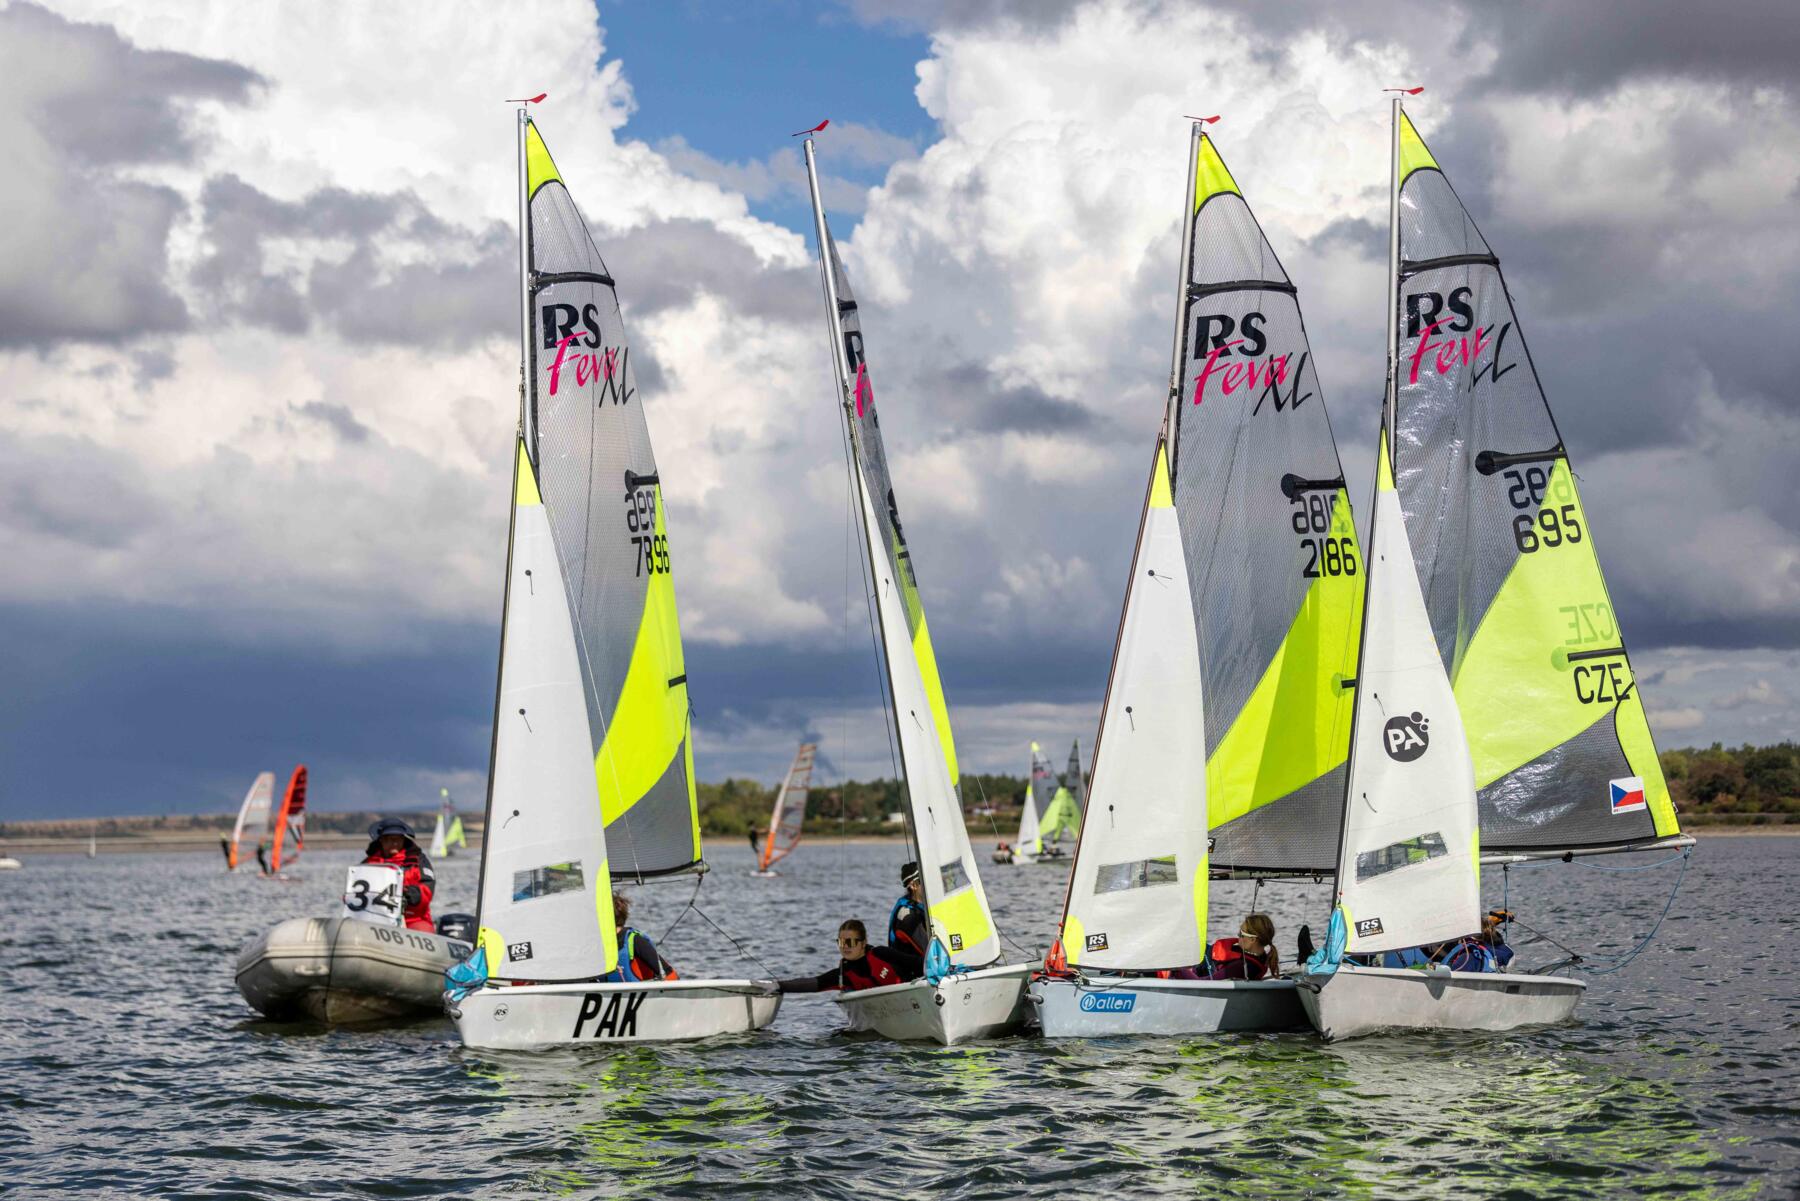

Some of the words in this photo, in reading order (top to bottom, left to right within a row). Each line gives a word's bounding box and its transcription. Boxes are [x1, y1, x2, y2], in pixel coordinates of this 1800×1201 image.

[542, 303, 602, 350] RS
[1406, 287, 1474, 339] RS
[1193, 311, 1267, 360] RS
[546, 331, 620, 396] Feva
[599, 346, 635, 408] XL
[1194, 339, 1291, 405] Feva
[1253, 351, 1313, 416] XL
[1512, 504, 1582, 554] 695
[630, 534, 670, 577] 7896
[1300, 537, 1357, 578] 2186
[1573, 662, 1631, 704] CZE
[1387, 725, 1426, 754] PA
[347, 879, 400, 914] 34
[369, 926, 405, 945] 106
[405, 933, 436, 952] 118
[1089, 934, 1105, 945] RS
[1360, 919, 1378, 931] RS
[511, 943, 529, 955] RS
[572, 991, 649, 1039] PAK
[1096, 996, 1132, 1010] allen
